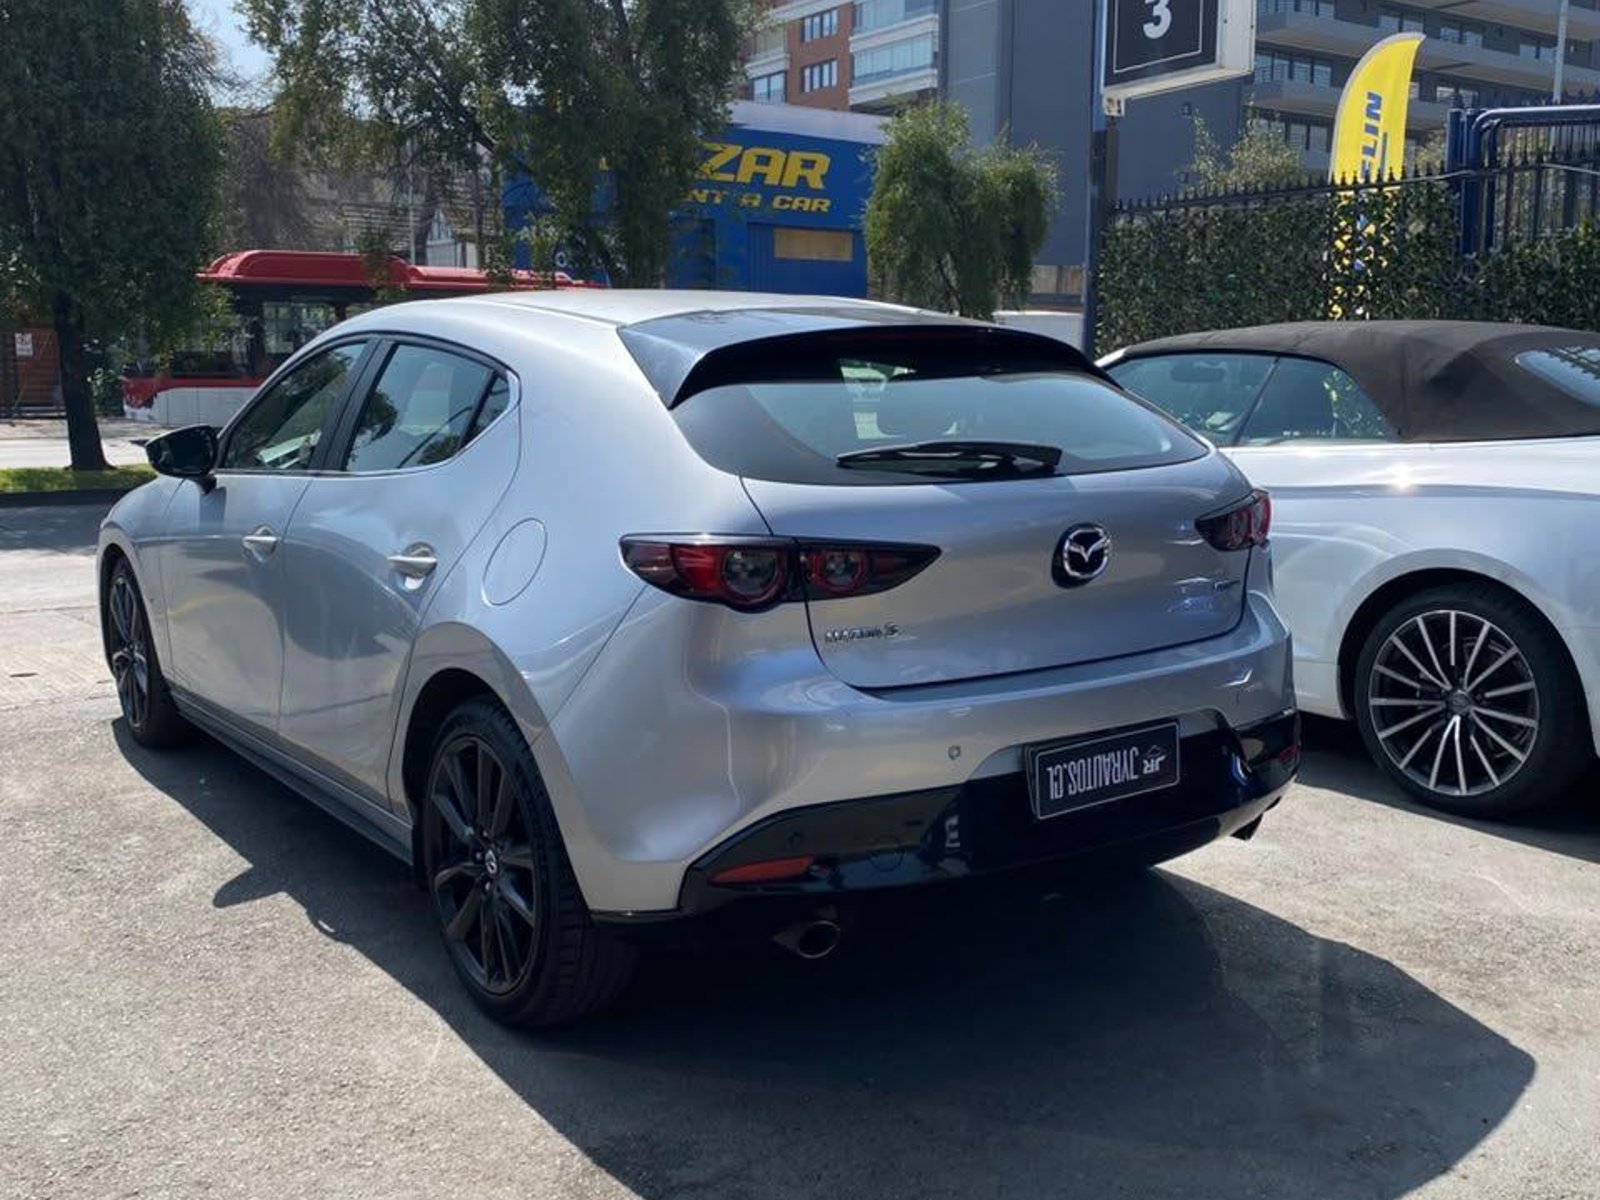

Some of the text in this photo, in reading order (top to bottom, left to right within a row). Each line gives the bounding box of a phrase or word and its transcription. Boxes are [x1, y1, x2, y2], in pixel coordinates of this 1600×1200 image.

[1143, 0, 1172, 39] 3
[695, 143, 831, 189] ZAR
[686, 188, 730, 204] NT
[773, 195, 831, 212] CAR
[1047, 747, 1139, 800] JYRAUTOS.CL
